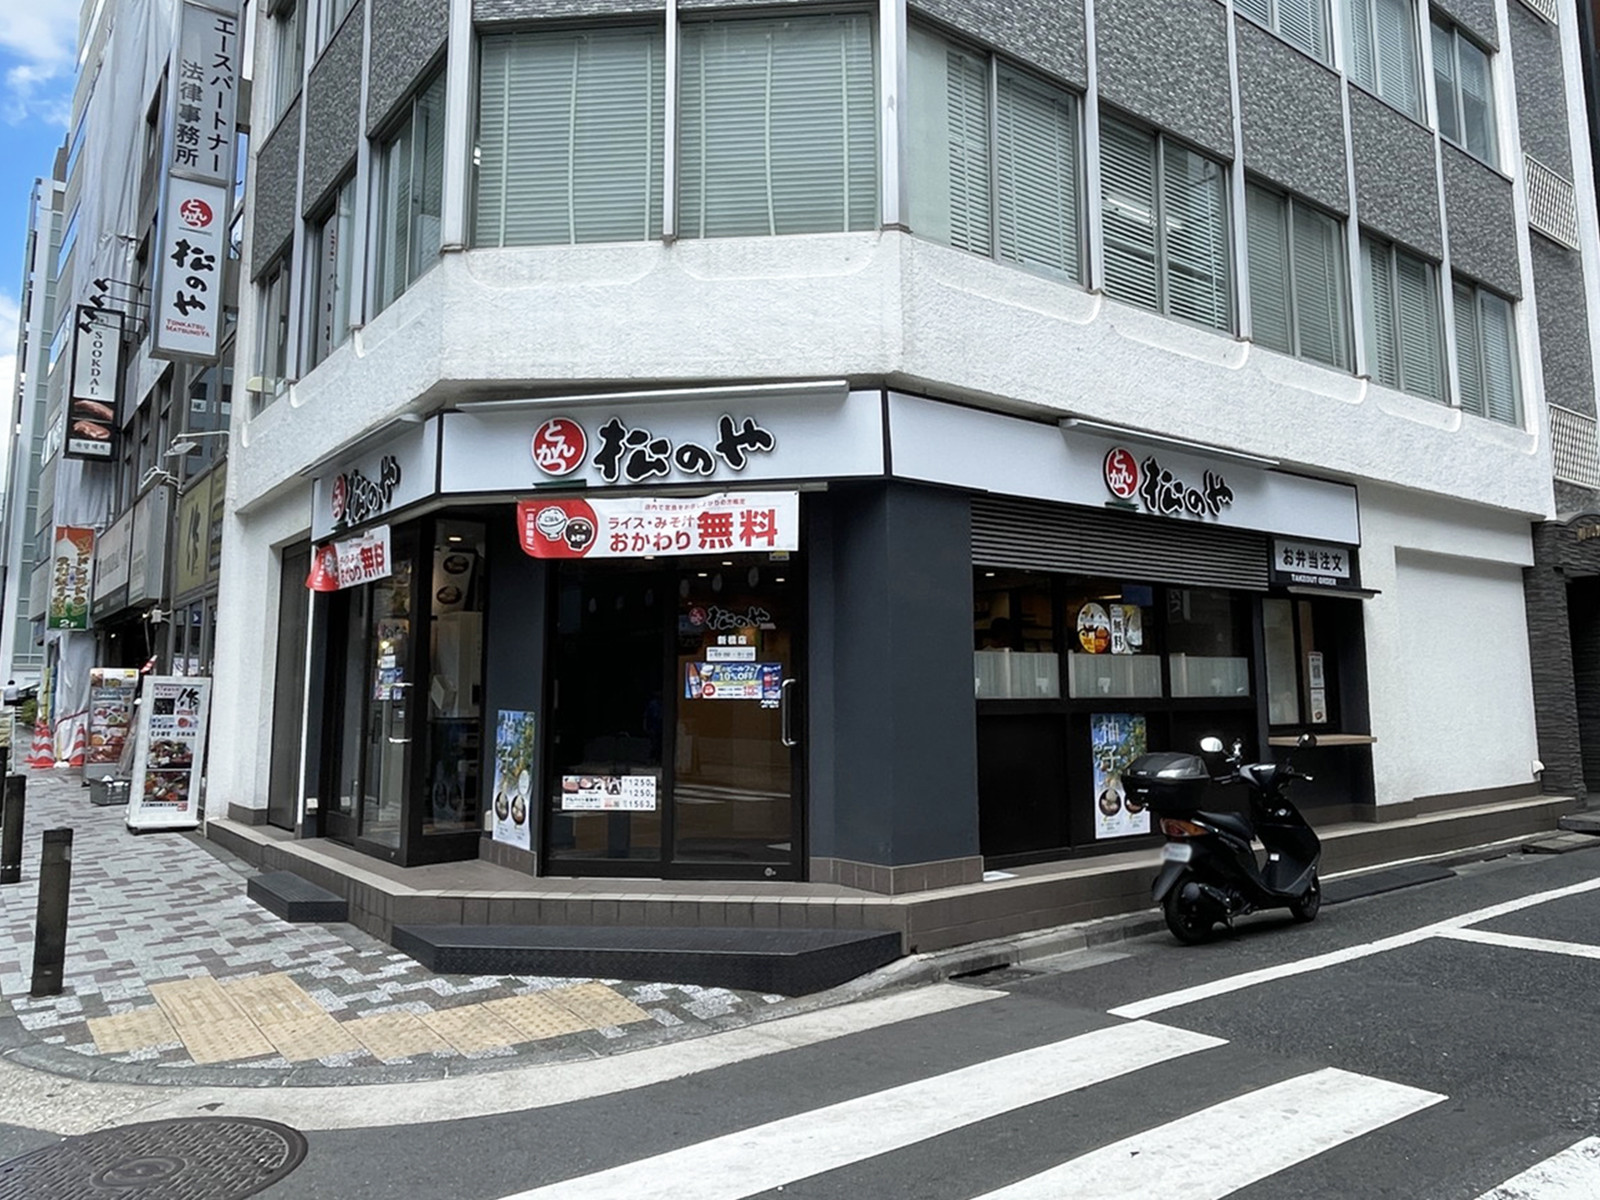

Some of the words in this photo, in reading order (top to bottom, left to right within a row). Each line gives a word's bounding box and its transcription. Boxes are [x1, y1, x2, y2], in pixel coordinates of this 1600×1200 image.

[175, 59, 204, 167] 法律事務所
[207, 18, 236, 172] エースパートナー
[171, 239, 215, 317] 松のや
[165, 325, 210, 338] MATSUNOYA
[166, 318, 206, 331] TONKATSU
[89, 331, 103, 395] SOOKDAL
[536, 420, 576, 473] とんかつ
[593, 414, 776, 482] 松のや
[1108, 449, 1134, 498] とんかつ
[1141, 456, 1234, 517] 松のや
[608, 514, 698, 530] ライス・みそ汁
[609, 531, 692, 552] おかわり
[697, 509, 778, 549] 無料
[1282, 547, 1342, 572] お弁当注文
[706, 605, 771, 631] 松のや
